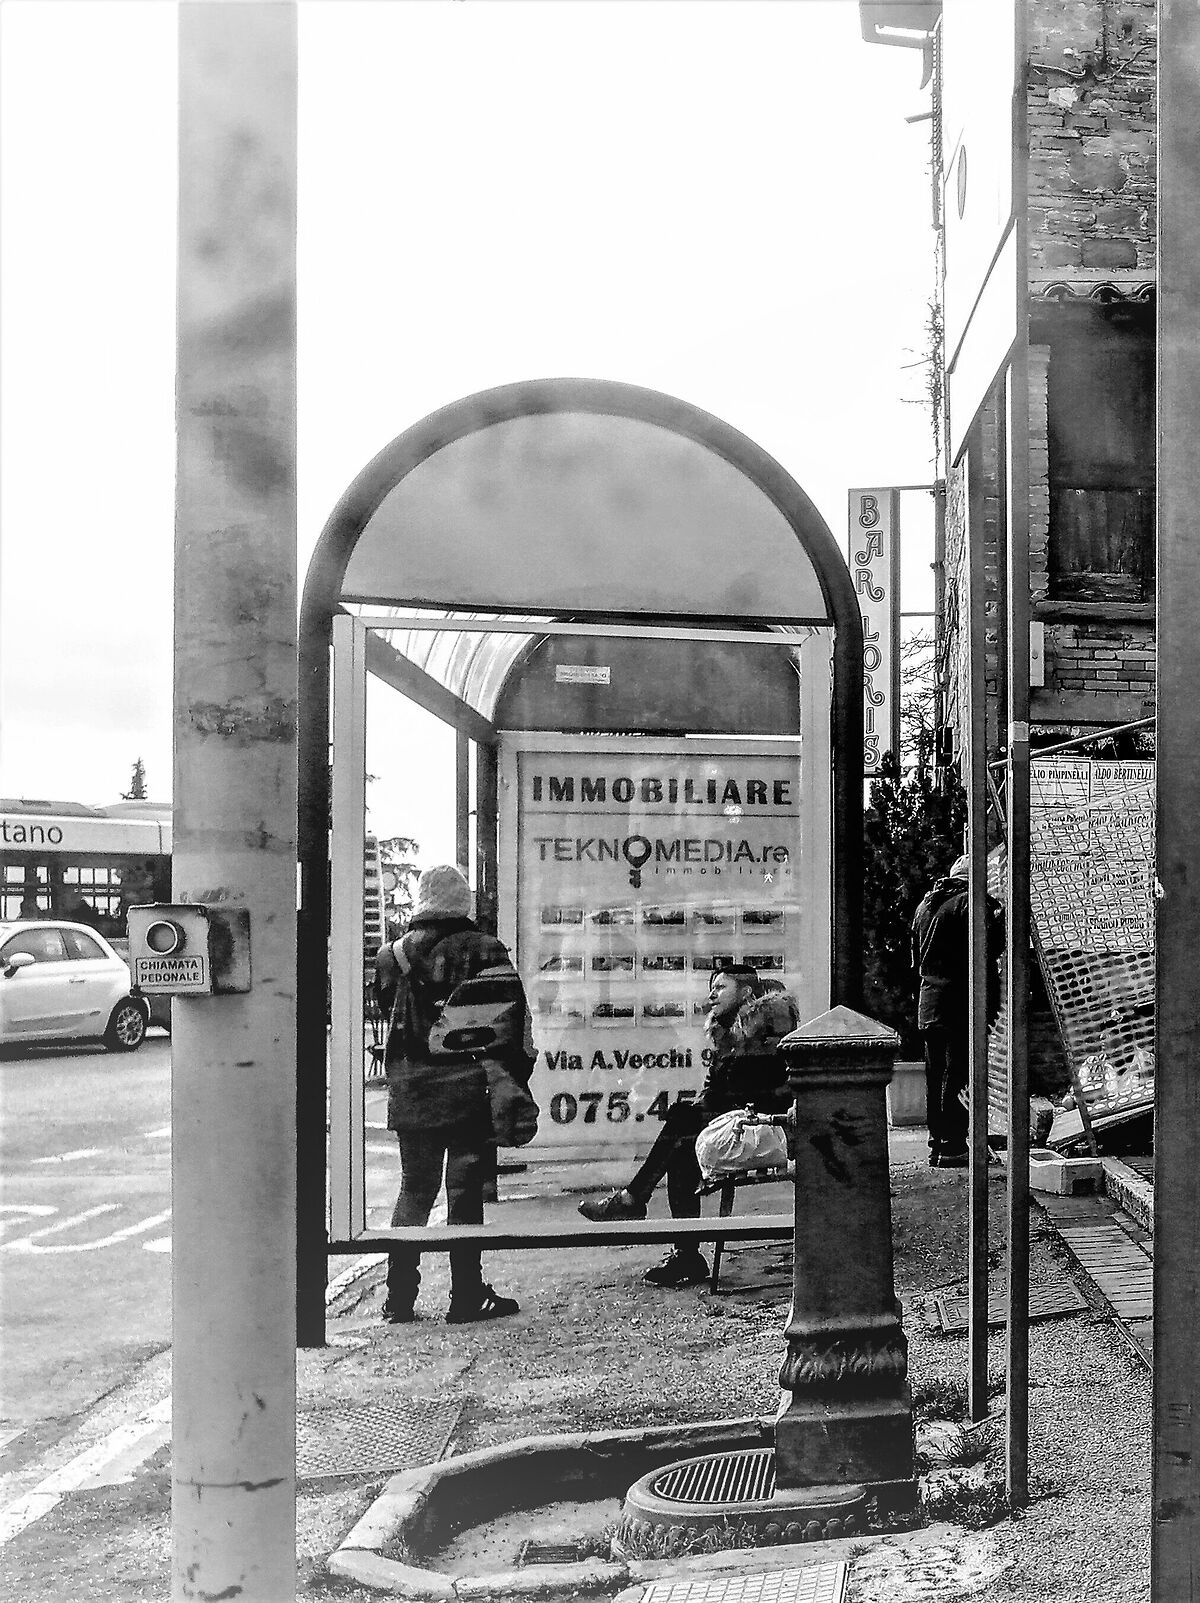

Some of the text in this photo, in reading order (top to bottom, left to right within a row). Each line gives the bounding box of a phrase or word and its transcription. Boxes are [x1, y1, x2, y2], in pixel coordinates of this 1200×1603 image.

[855, 495, 886, 767] BAR LORIS
[532, 775, 793, 806] IMMOBILIARE
[140, 960, 199, 970] CHIAMATA
[140, 972, 200, 983] PEDONALE
[544, 1050, 583, 1070] Via
[590, 1049, 692, 1070] A.Vecchi
